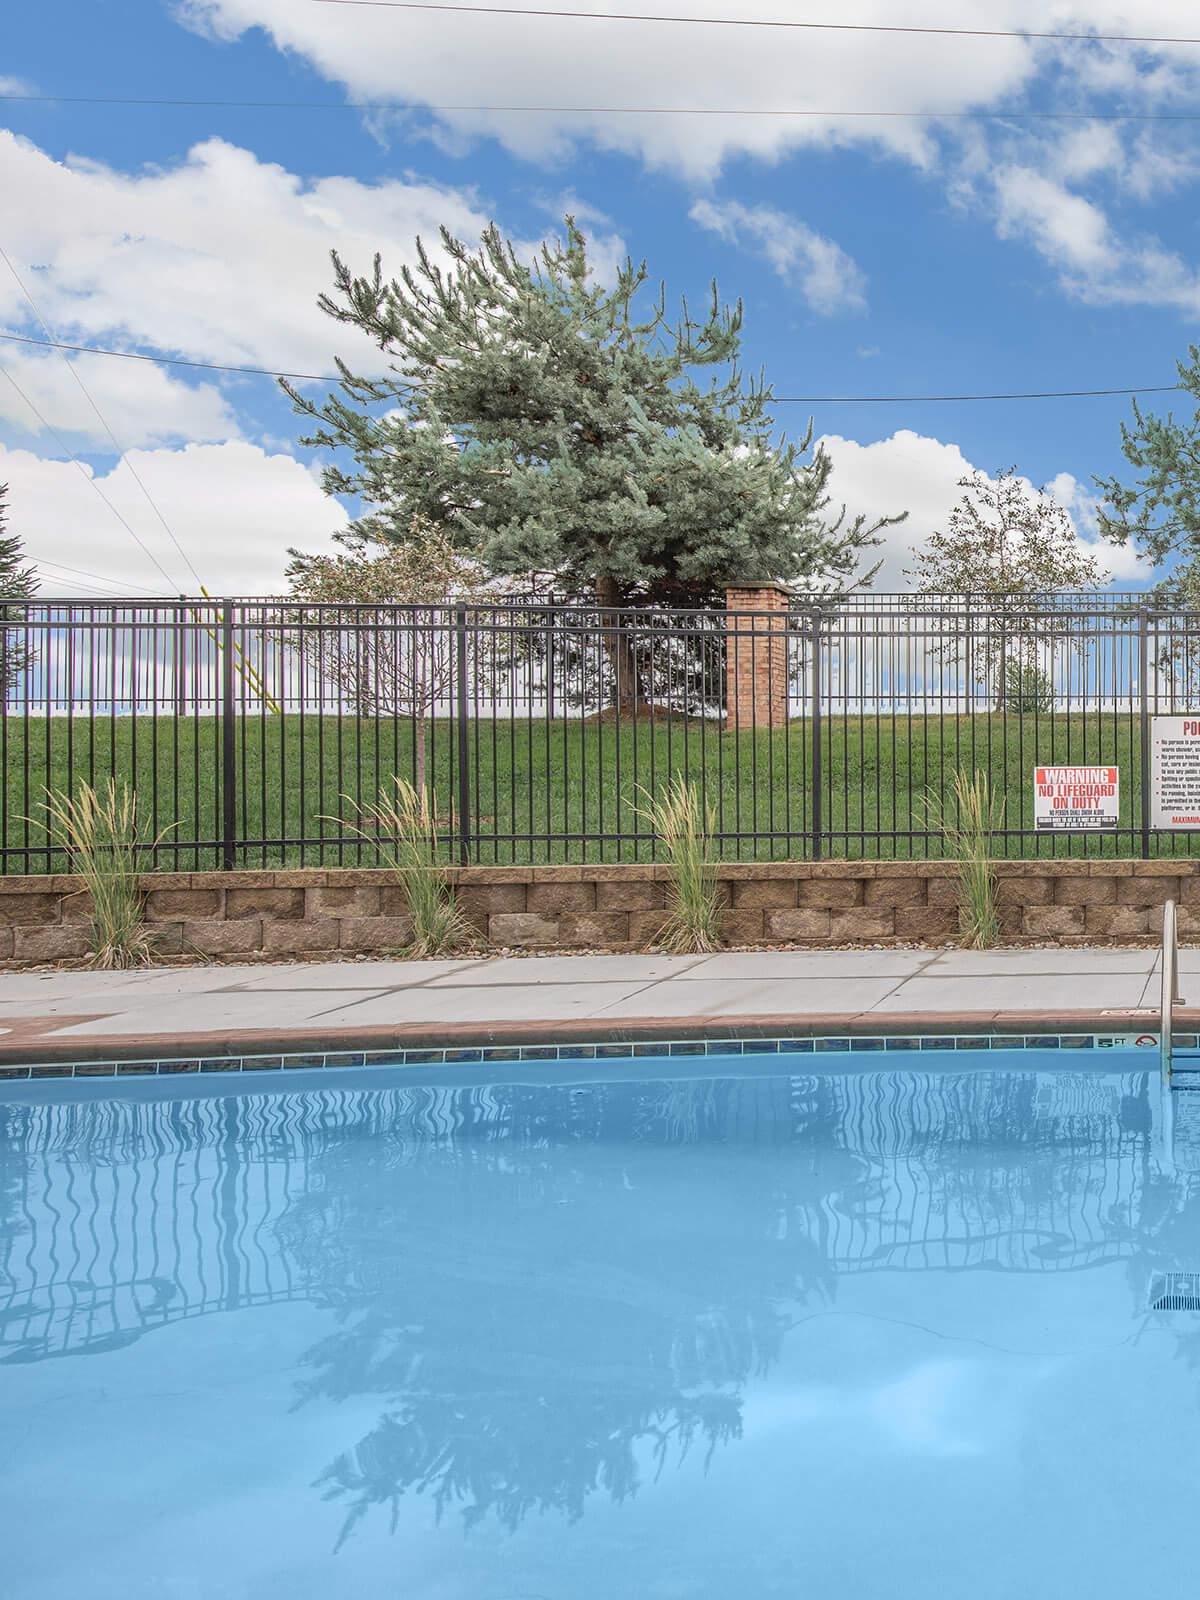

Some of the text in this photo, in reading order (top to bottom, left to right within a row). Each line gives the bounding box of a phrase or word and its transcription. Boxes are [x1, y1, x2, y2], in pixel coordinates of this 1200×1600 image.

[1045, 769, 1109, 784] WARNING
[1038, 785, 1115, 797] NO LIFEGUARD
[1053, 798, 1100, 809] ON DUTY
[1097, 1038, 1113, 1047] 5
